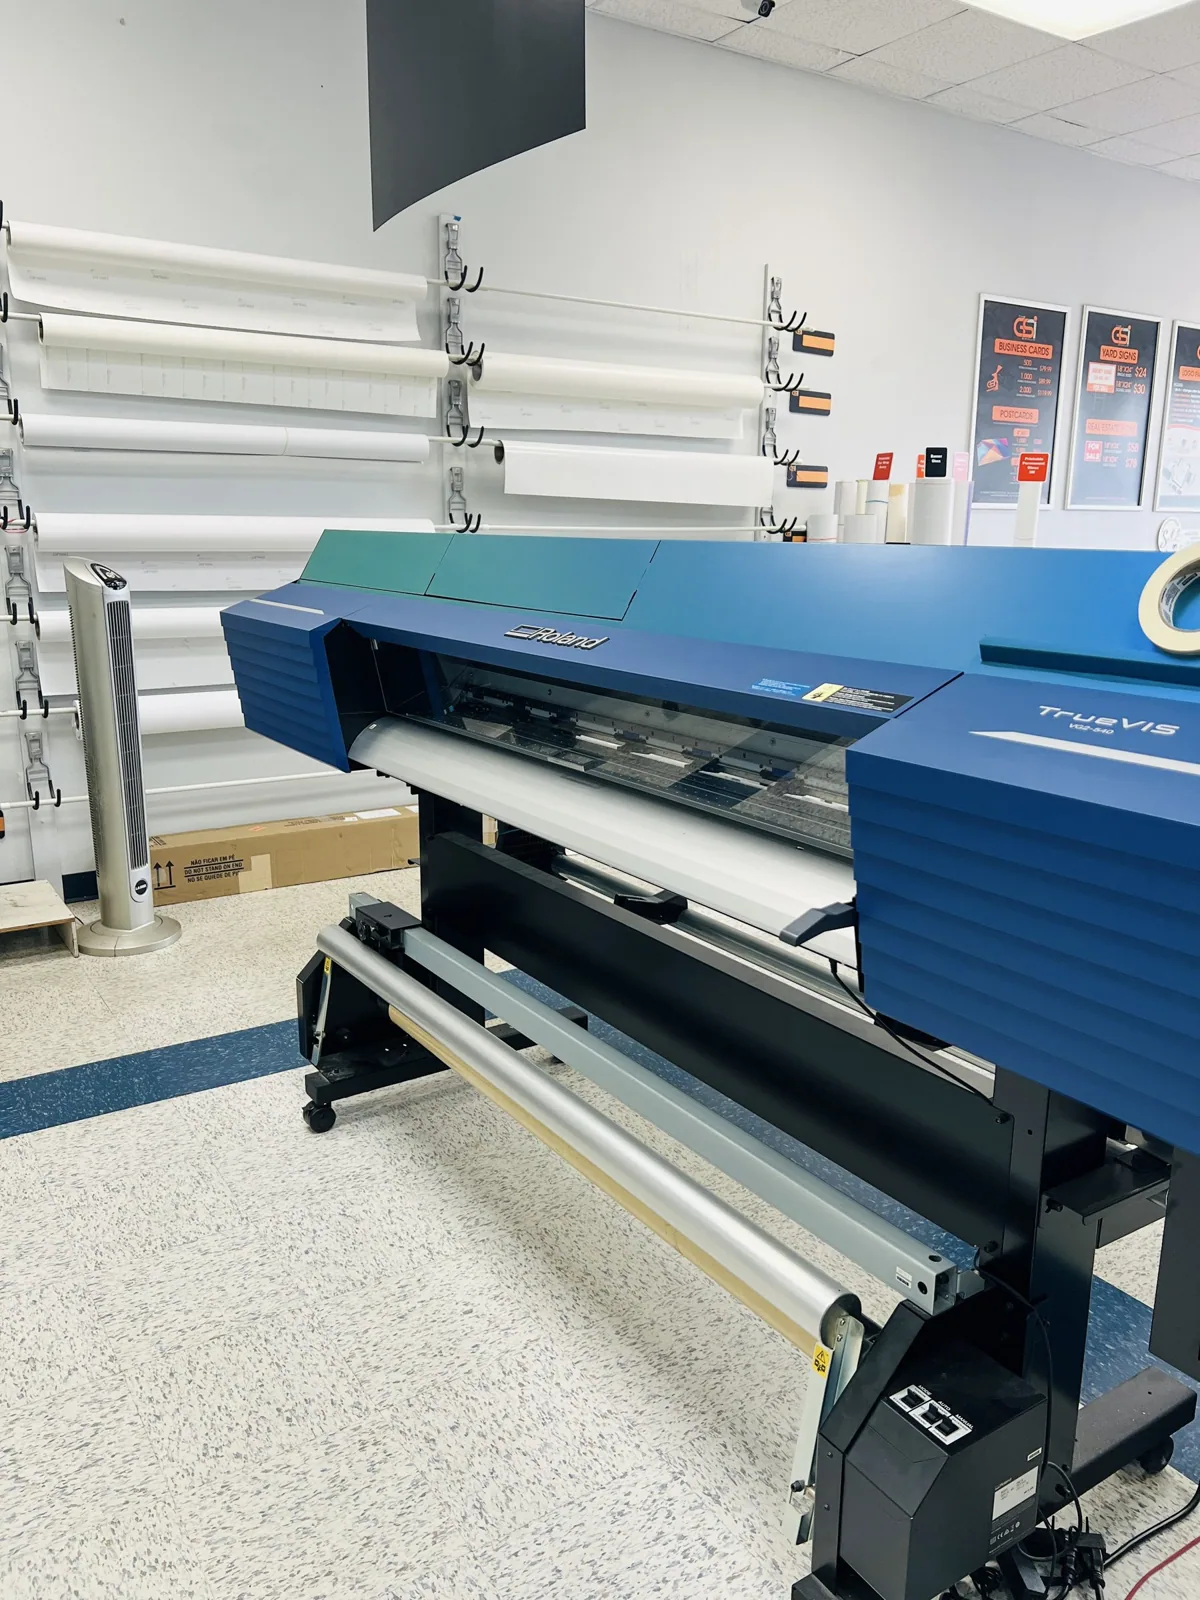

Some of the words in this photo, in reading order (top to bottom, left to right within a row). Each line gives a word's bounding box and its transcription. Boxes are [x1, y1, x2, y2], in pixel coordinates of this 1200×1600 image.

[998, 341, 1027, 354] BUSINESS
[1028, 345, 1050, 356] CARDS
[1102, 348, 1118, 359] YARD
[1118, 350, 1137, 361] SIGNS
[1134, 365, 1147, 377] $24
[1000, 409, 1034, 420] POSTCARDS
[527, 627, 611, 651] Roland
[1068, 722, 1115, 735] VG2-540
[203, 857, 219, 865] FICAR
[193, 866, 205, 874] NOT
[205, 864, 222, 872] STAND
[937, 1400, 951, 1411] AUTO
[955, 1413, 974, 1429] MANUAL
